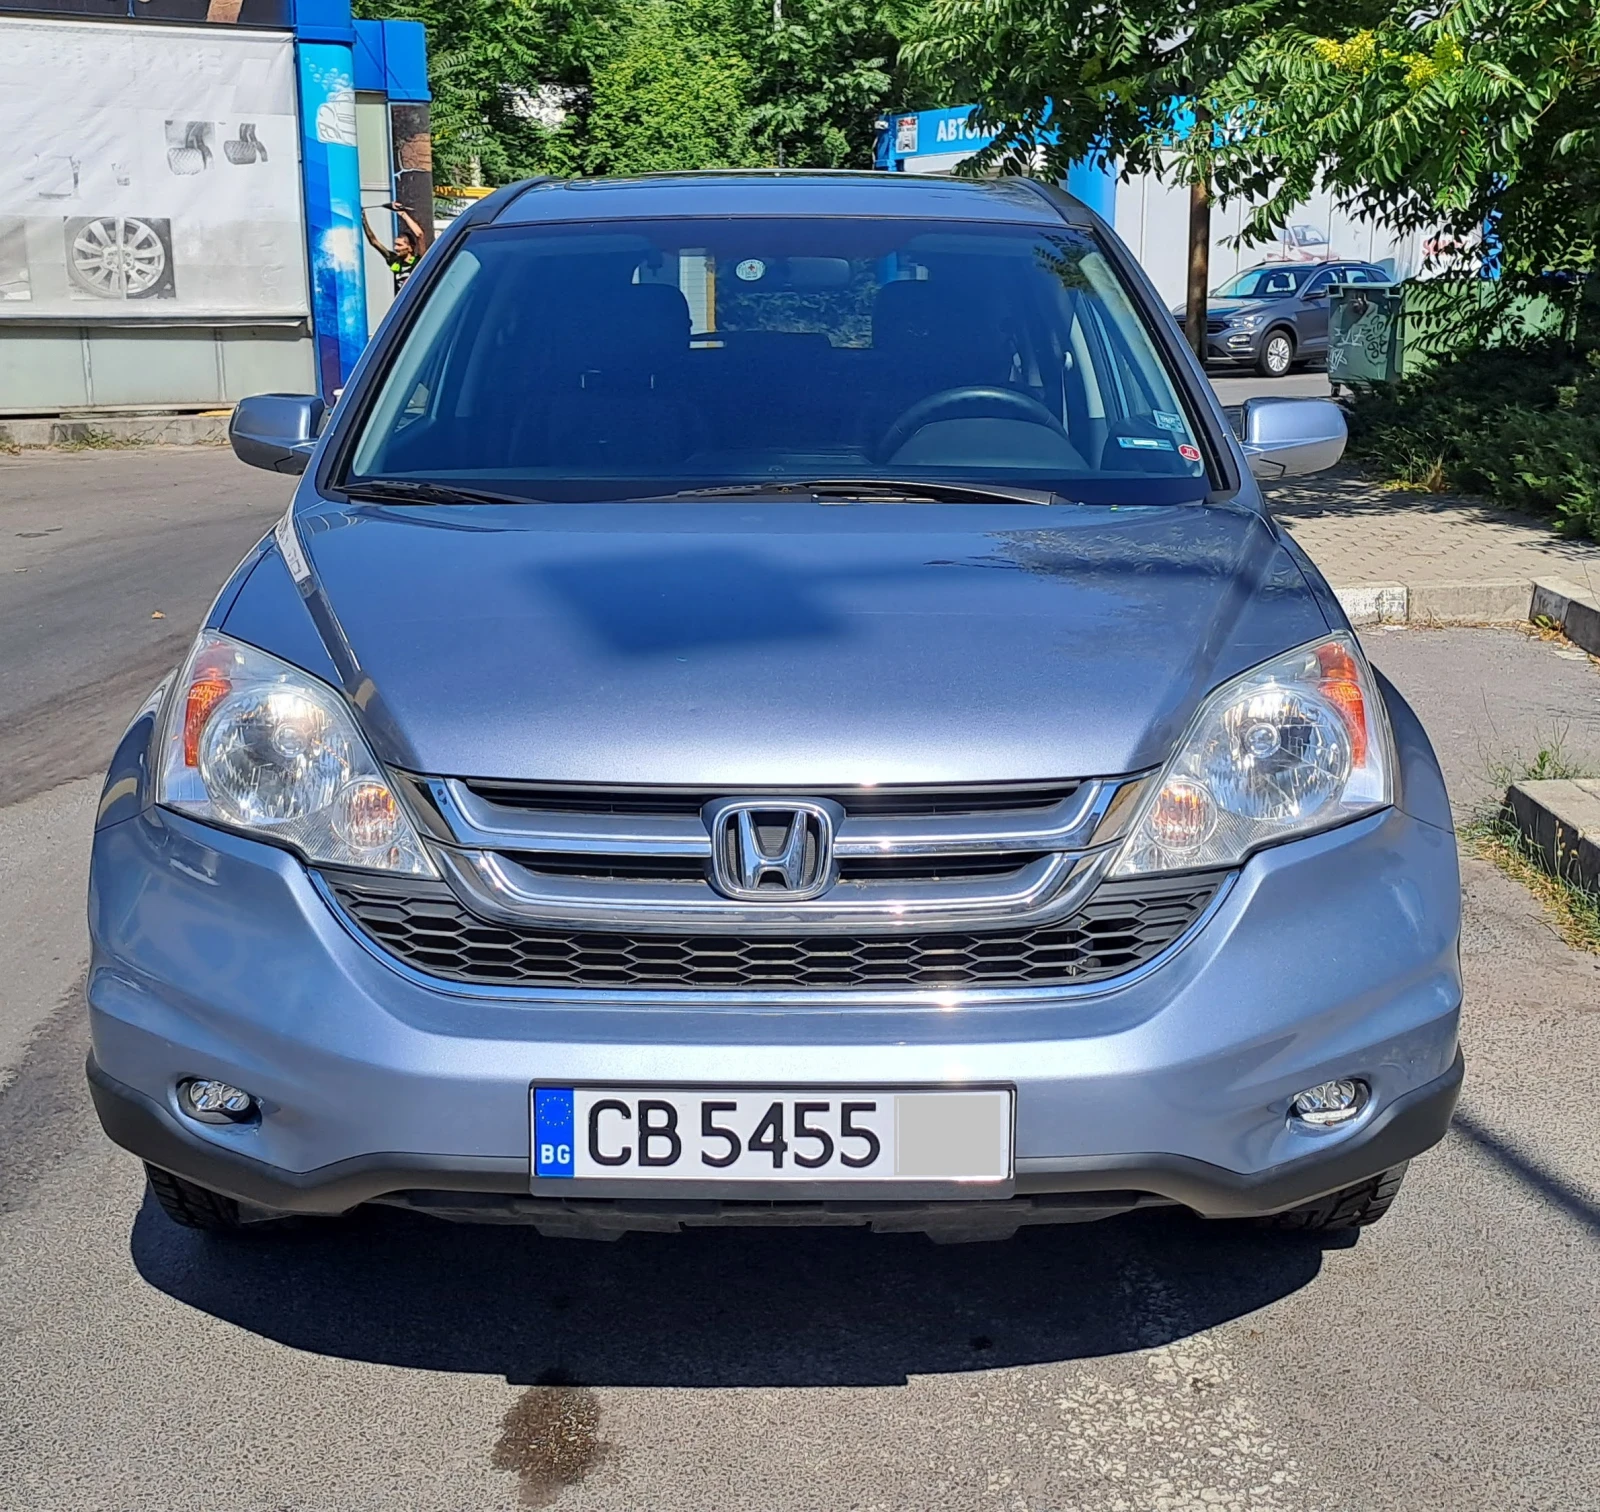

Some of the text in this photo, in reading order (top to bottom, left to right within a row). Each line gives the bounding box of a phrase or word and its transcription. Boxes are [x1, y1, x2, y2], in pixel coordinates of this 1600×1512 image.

[541, 1144, 571, 1164] BG
[588, 1099, 880, 1169] CB 5455
